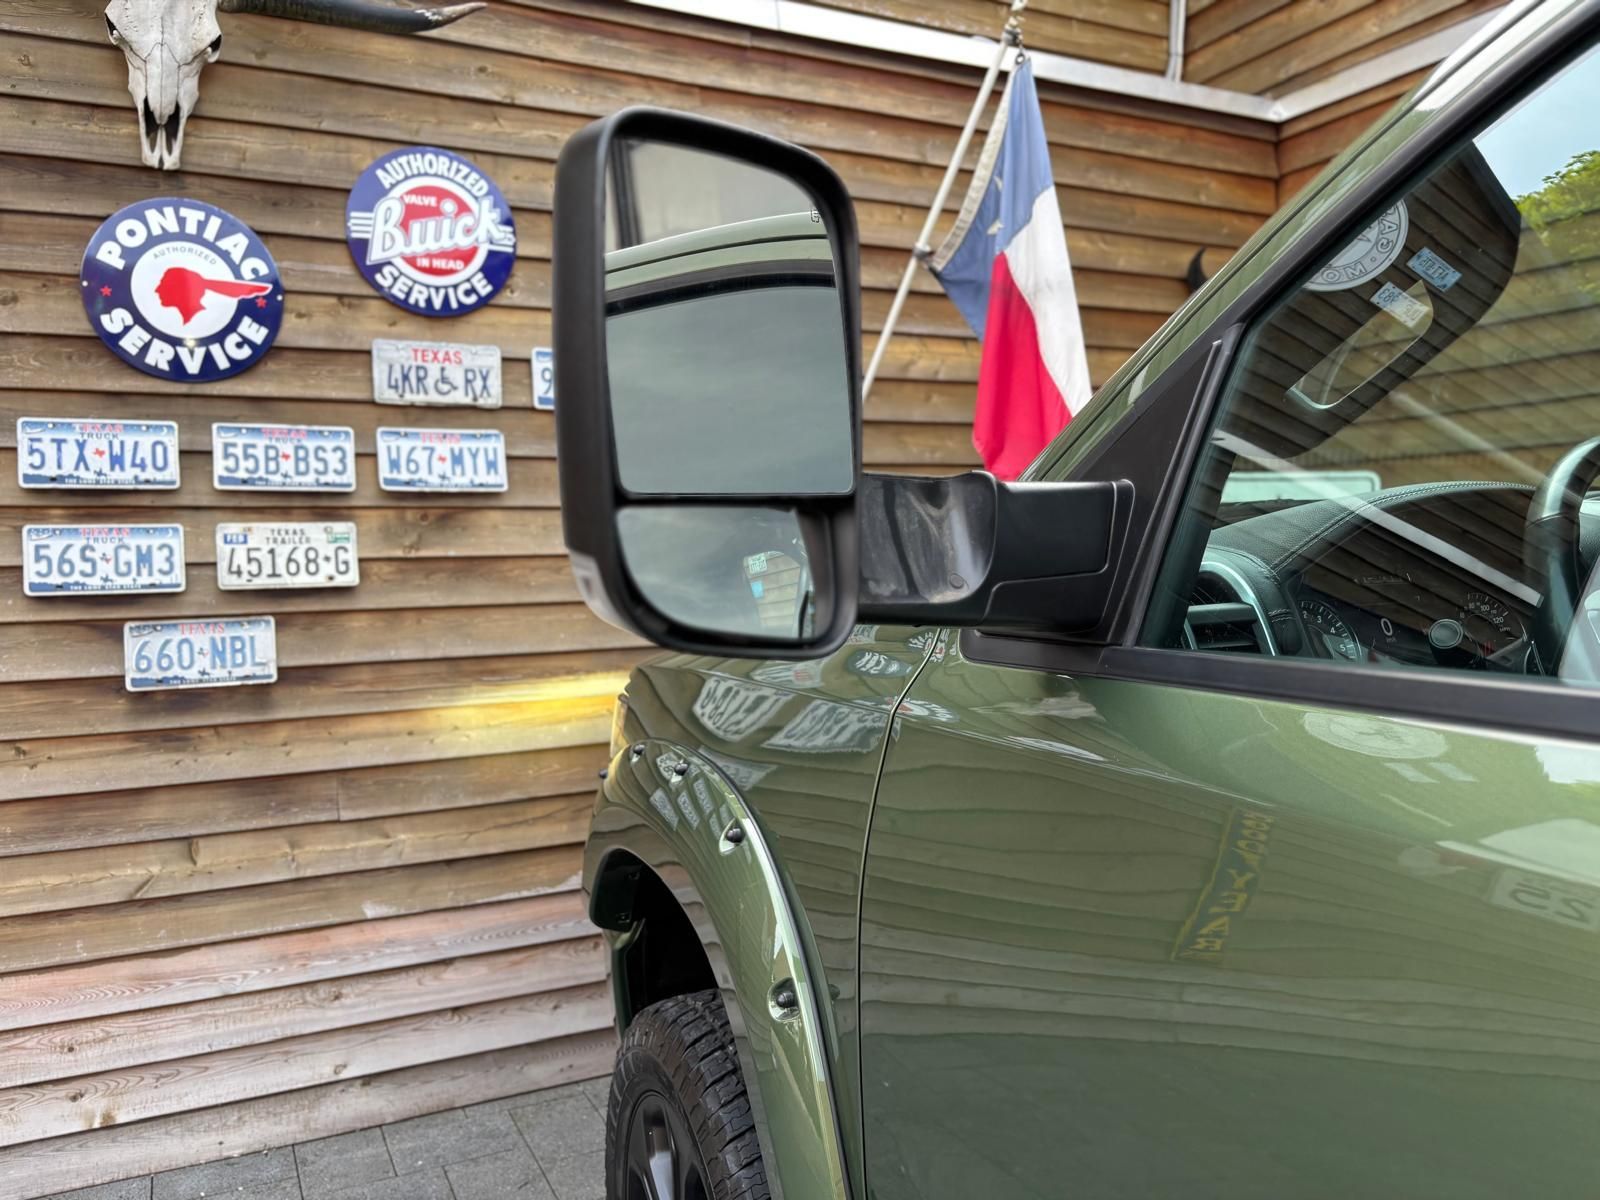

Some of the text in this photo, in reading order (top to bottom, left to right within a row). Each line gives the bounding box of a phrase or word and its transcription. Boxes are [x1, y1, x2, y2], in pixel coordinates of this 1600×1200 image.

[375, 153, 489, 196] AUTHORIZED
[403, 194, 438, 207] VALVE
[366, 195, 504, 266] Buick
[95, 206, 270, 281] PONTIAC
[153, 246, 217, 266] AUTHORIZED
[416, 258, 465, 271] IN HEAD
[374, 264, 494, 311] SERVICE
[100, 307, 270, 375] SERVICE
[412, 348, 463, 365] TEXAS
[81, 527, 131, 537] TEXAS
[270, 527, 306, 537] TEXAS
[86, 536, 124, 544] TRUCK
[265, 536, 311, 545] TRAILER
[179, 623, 226, 635] TEXAS
